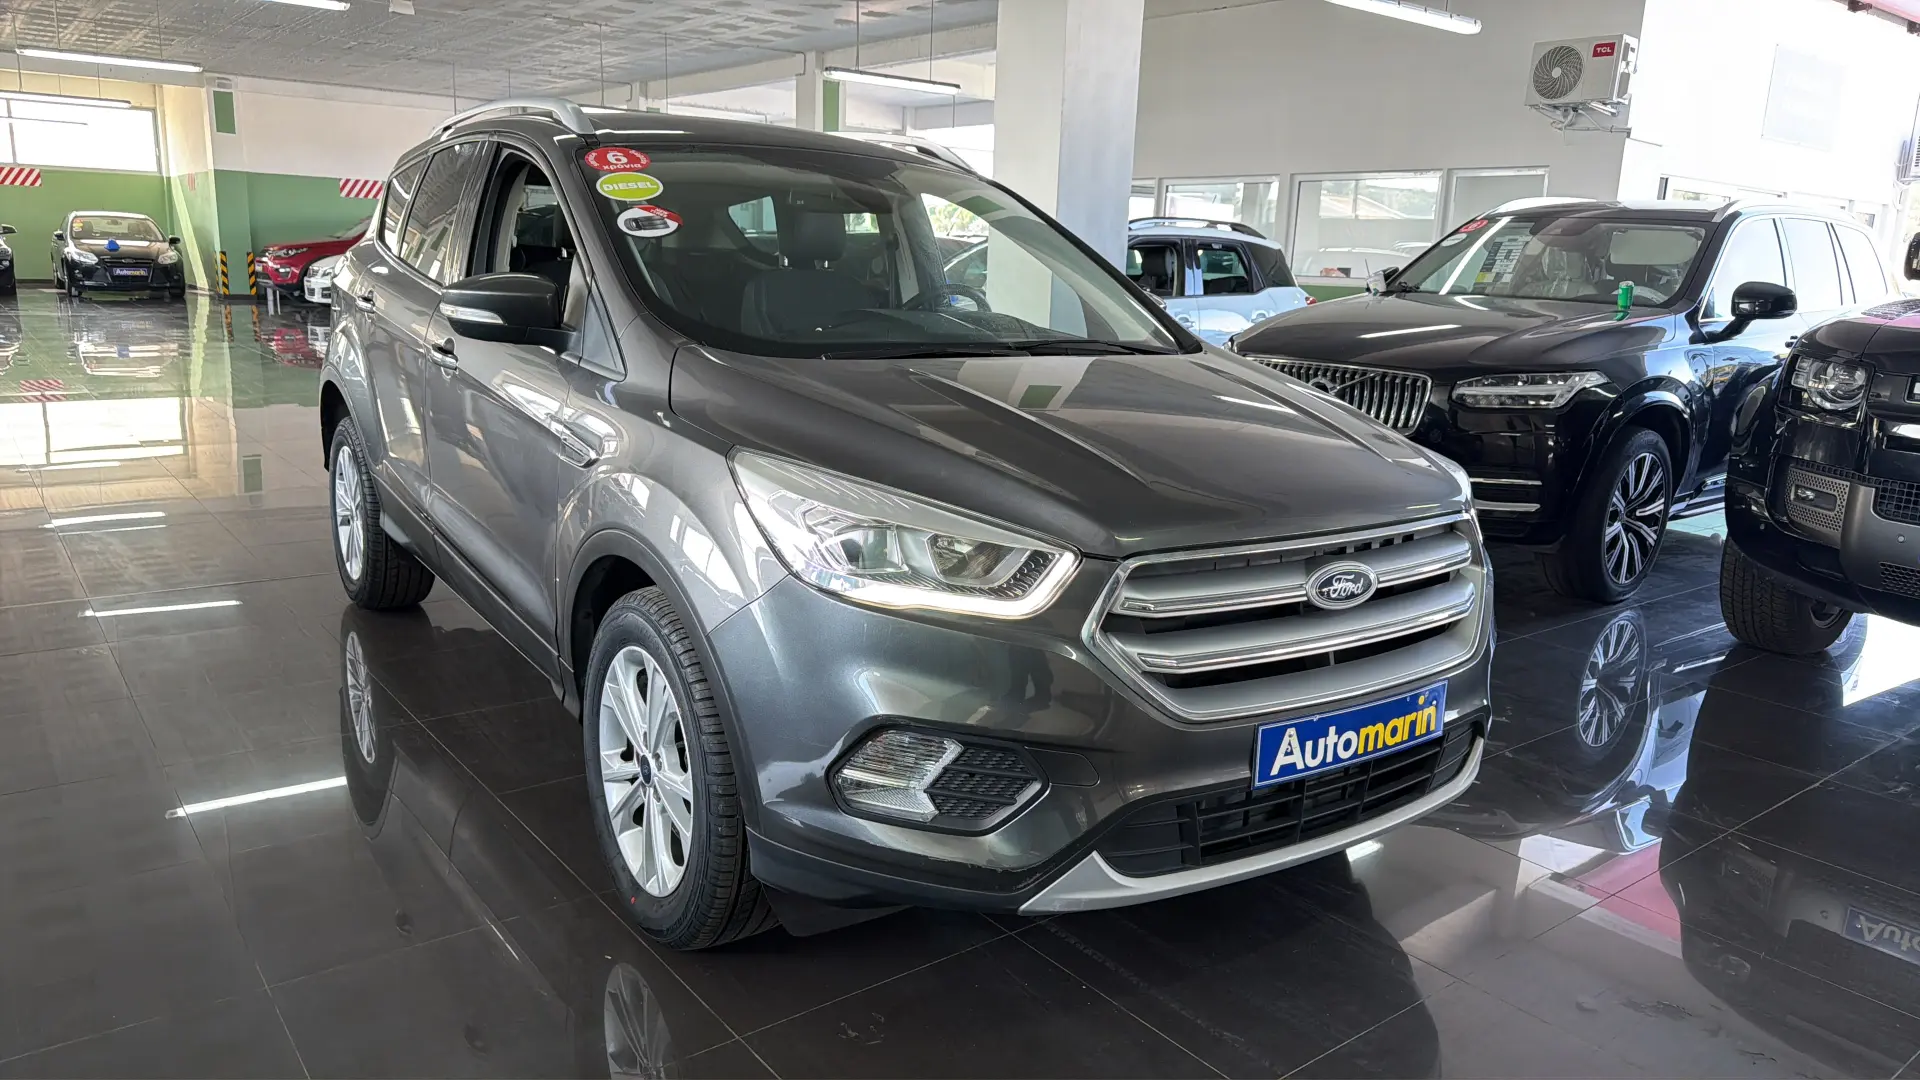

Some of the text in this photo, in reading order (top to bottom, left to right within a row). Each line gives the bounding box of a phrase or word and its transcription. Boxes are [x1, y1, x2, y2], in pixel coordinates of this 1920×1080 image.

[606, 152, 628, 164] 6
[602, 181, 657, 191] DIESEL
[1321, 574, 1364, 598] Ford
[1269, 695, 1437, 776] Automarin
